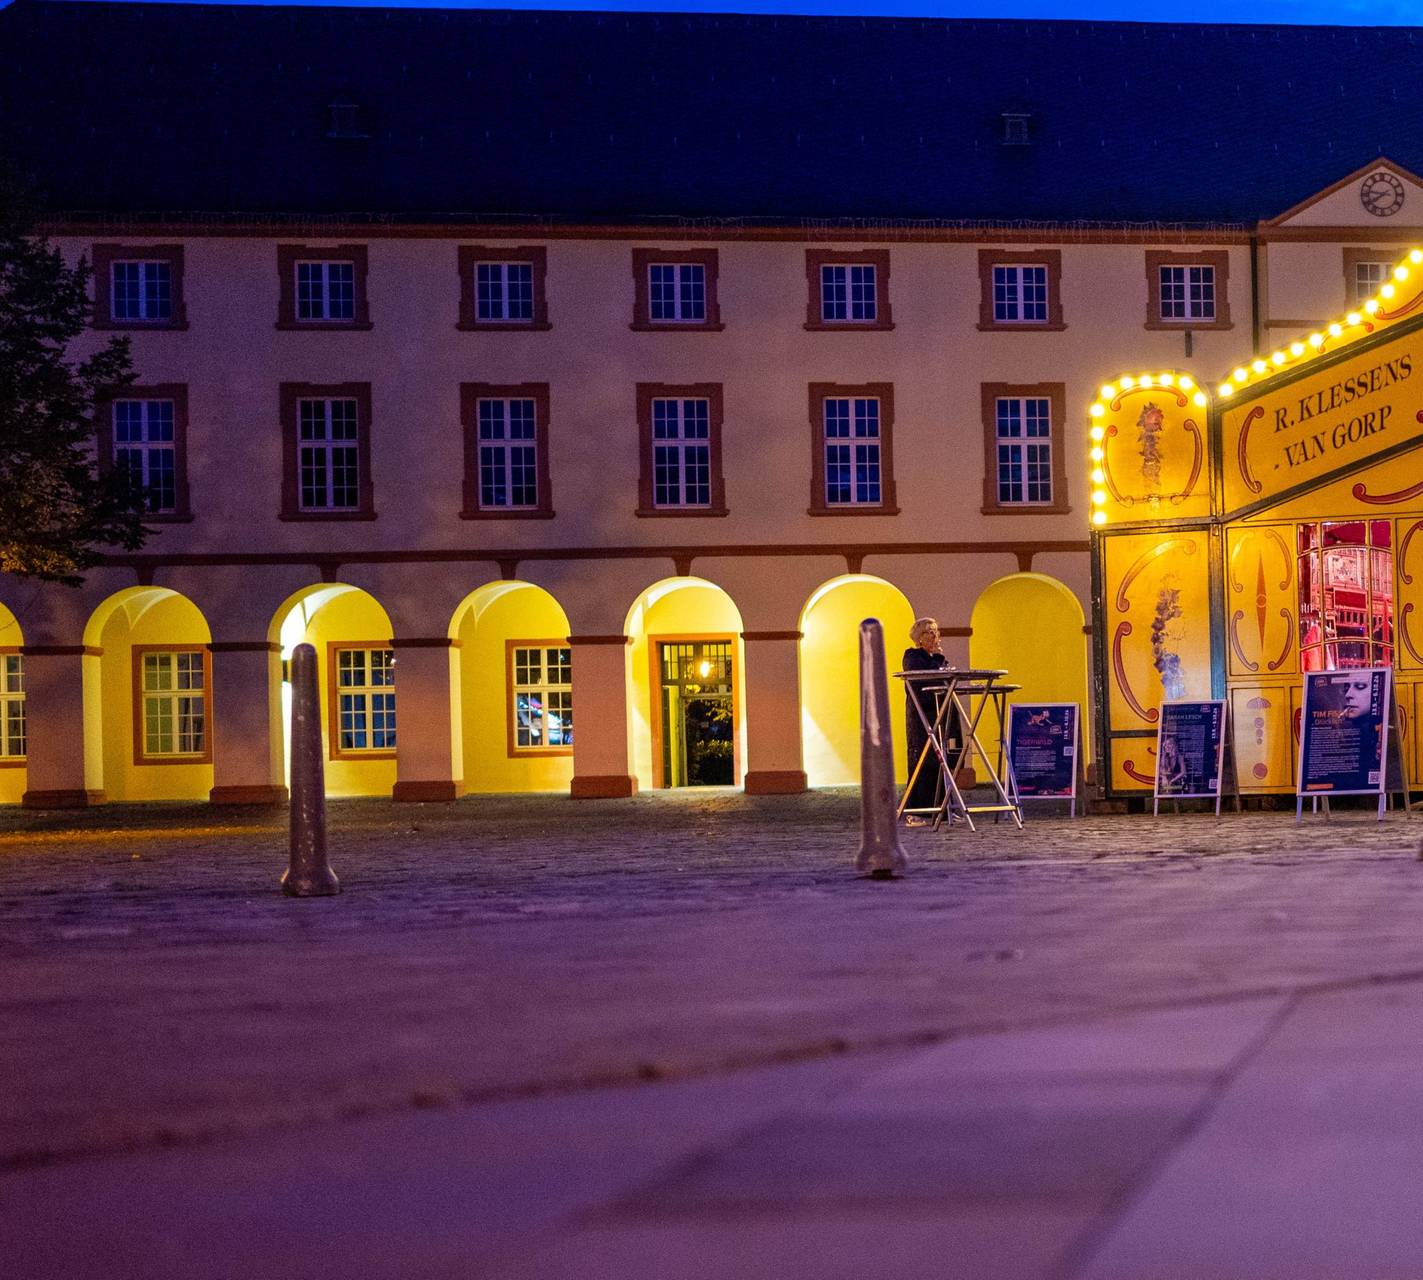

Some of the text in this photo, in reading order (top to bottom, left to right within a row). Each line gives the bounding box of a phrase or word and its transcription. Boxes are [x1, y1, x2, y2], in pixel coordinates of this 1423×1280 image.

[1297, 353, 1413, 423] KLESSENS
[1284, 431, 1327, 469] VAN
[1331, 405, 1392, 450] GORP
